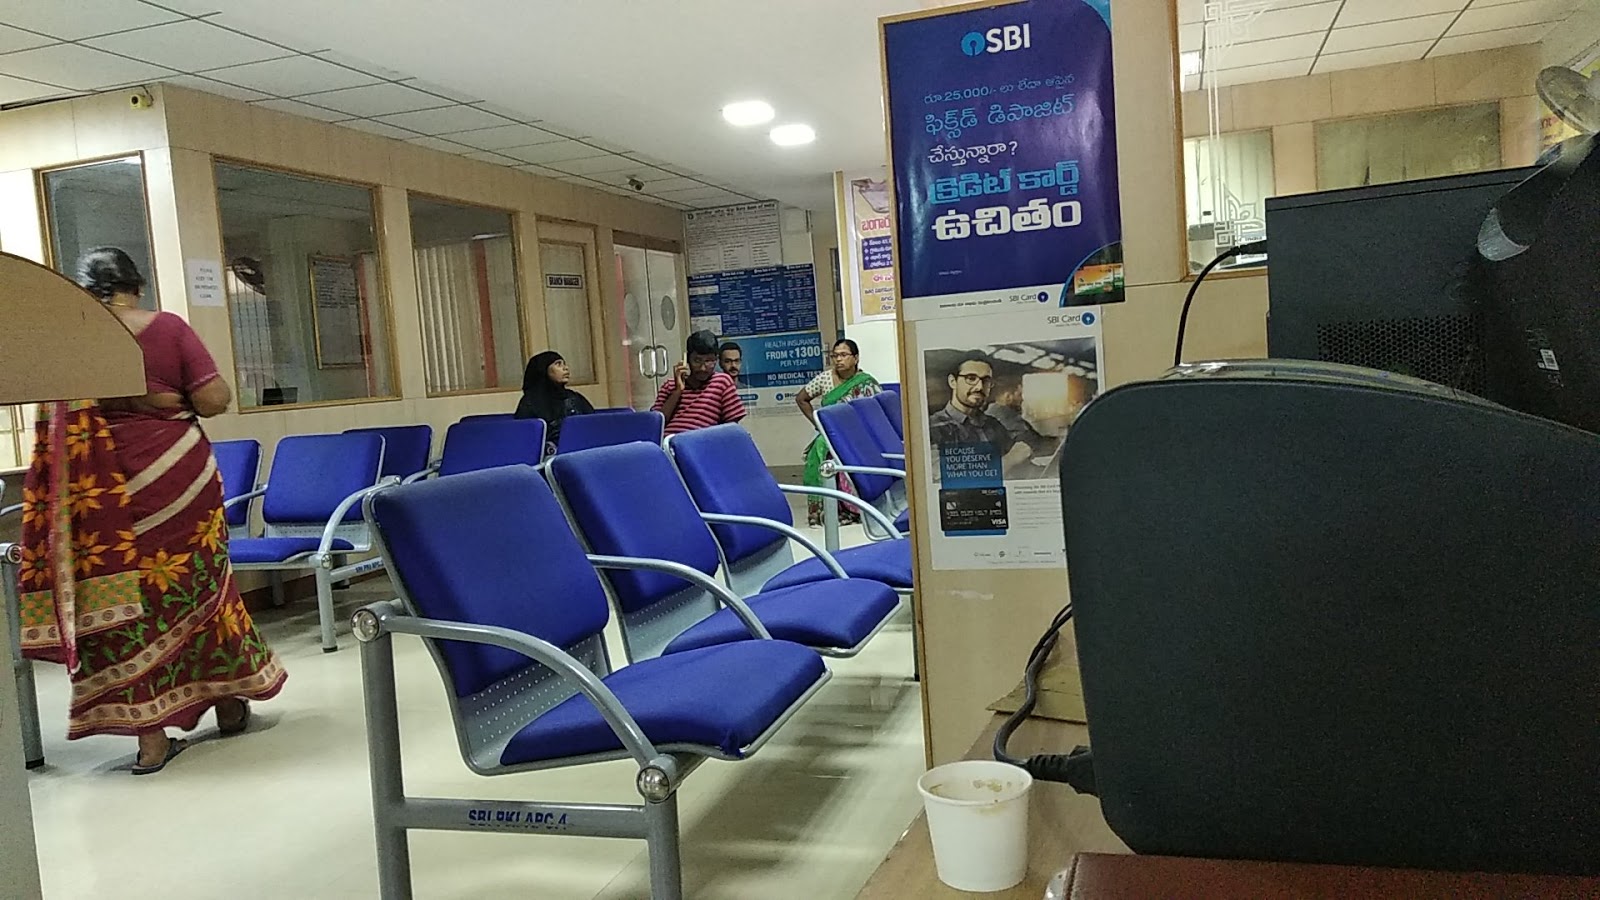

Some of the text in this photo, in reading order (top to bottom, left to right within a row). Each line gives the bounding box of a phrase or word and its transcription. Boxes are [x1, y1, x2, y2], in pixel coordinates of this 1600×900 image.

[986, 23, 1031, 53] SBI
[987, 93, 1075, 124] డిపాజిట్
[1016, 160, 1080, 196] కార్డ్
[931, 198, 1082, 241] ఉచితం
[1047, 314, 1081, 324] SBI Card
[765, 338, 820, 348] HEALTH INSURANCE
[765, 350, 788, 360] FROM
[777, 372, 805, 380] MEDICAL
[945, 447, 975, 455] BECAUSE
[962, 454, 991, 462] DESERVE
[984, 469, 997, 477] GET
